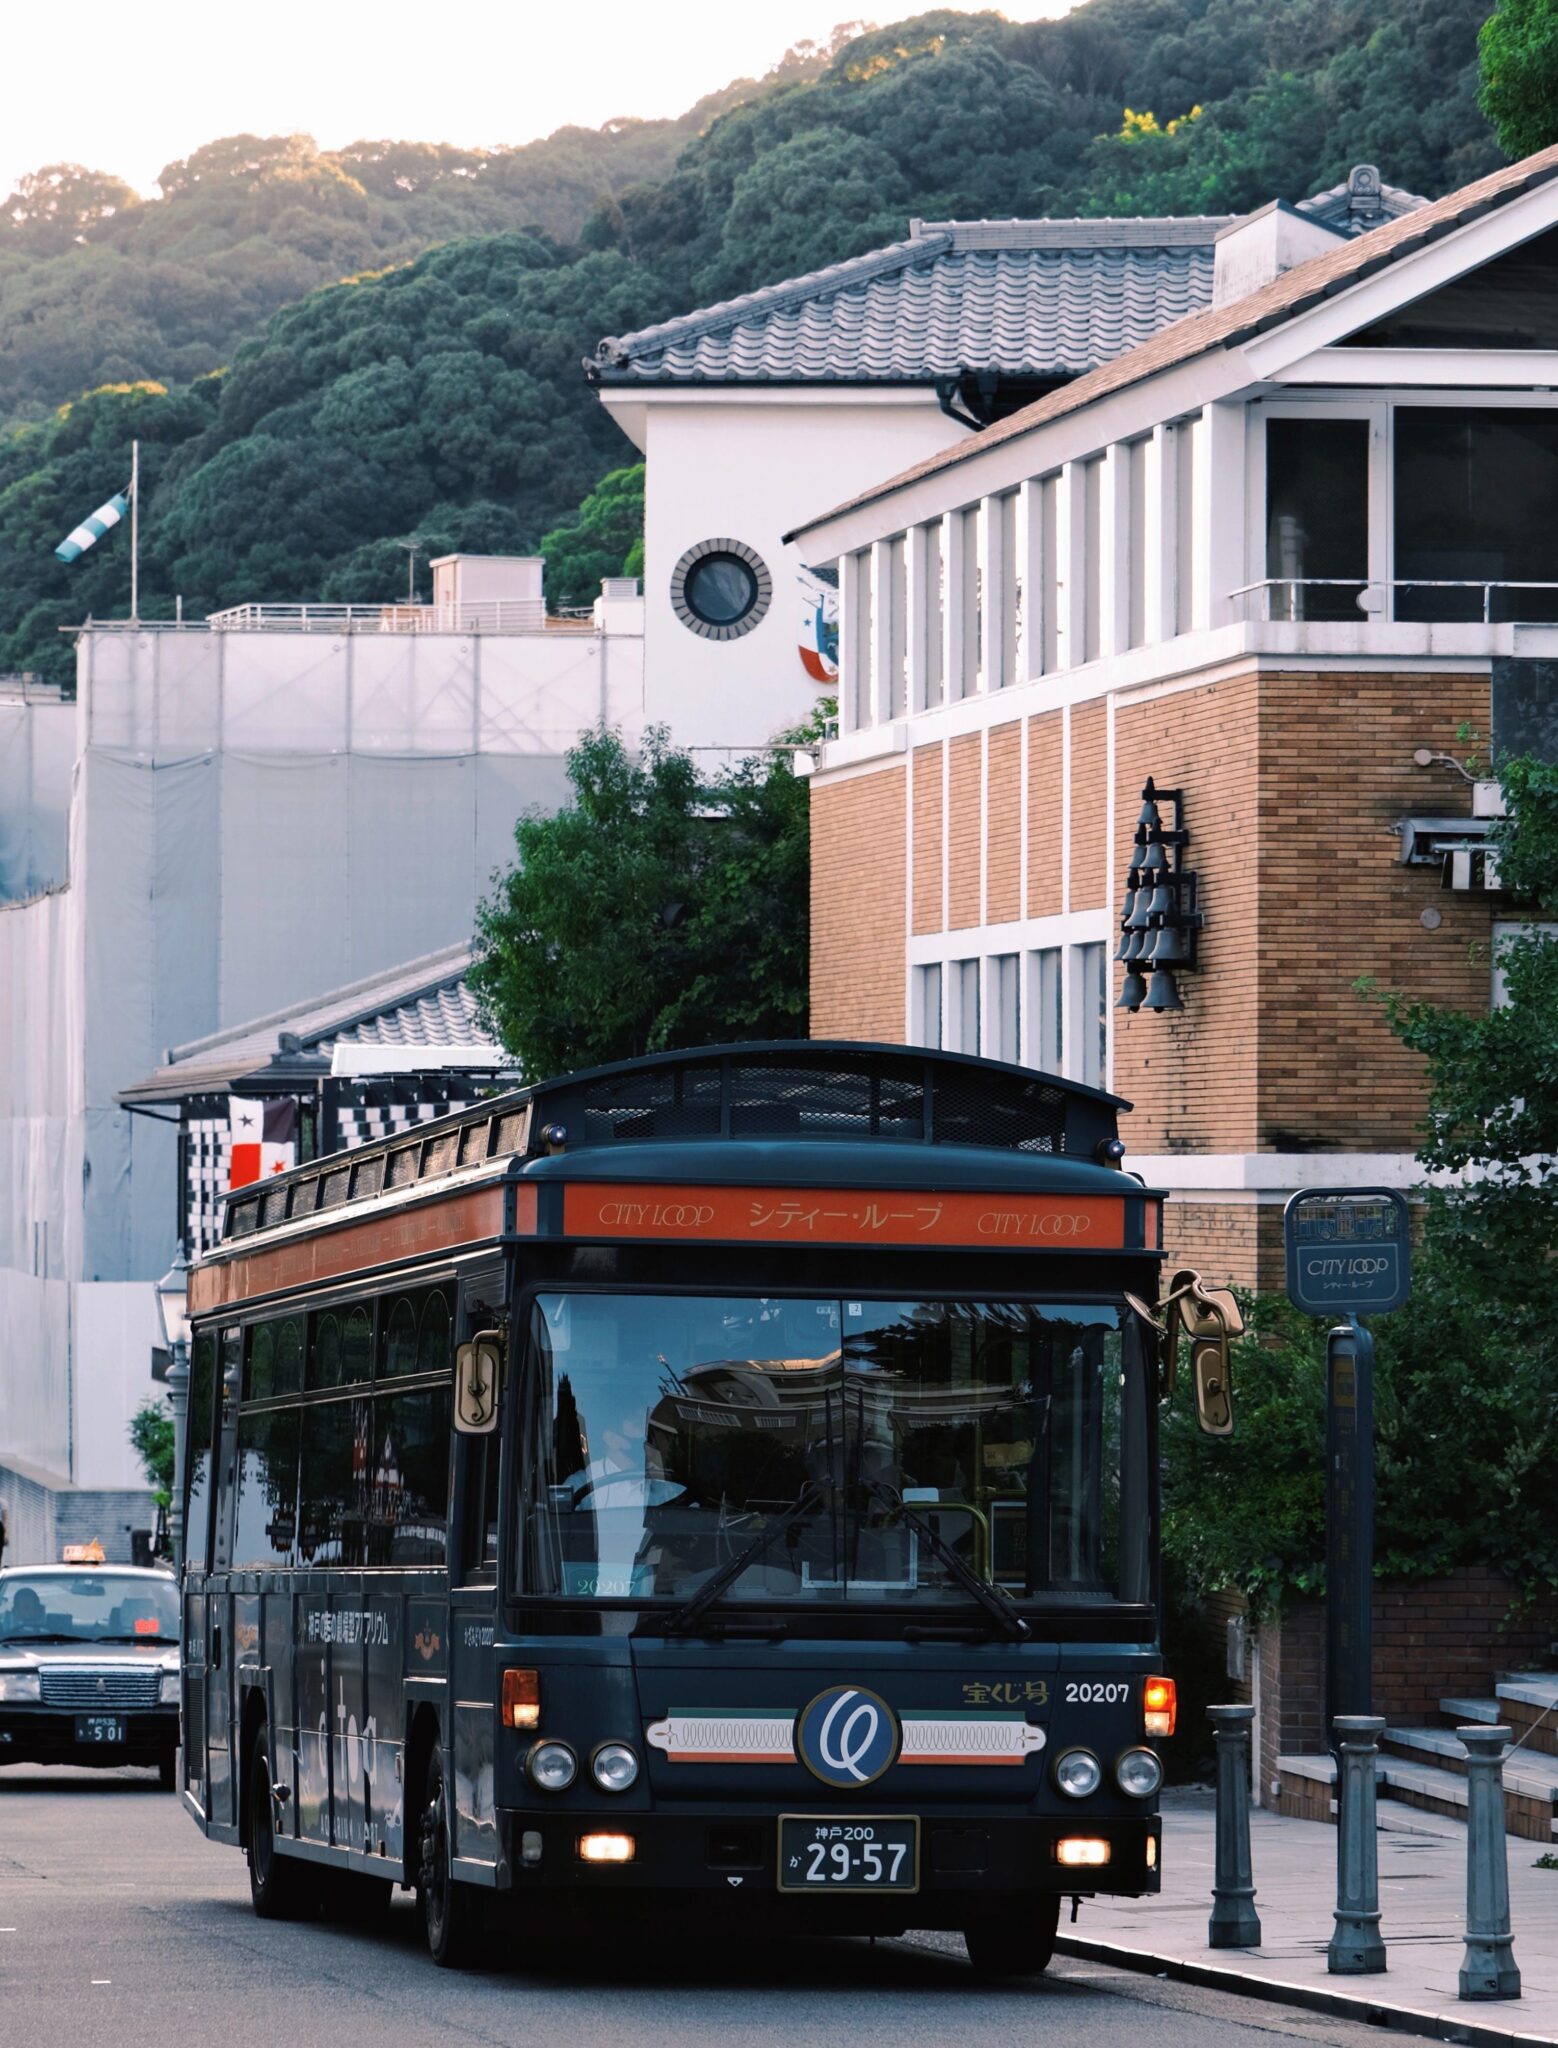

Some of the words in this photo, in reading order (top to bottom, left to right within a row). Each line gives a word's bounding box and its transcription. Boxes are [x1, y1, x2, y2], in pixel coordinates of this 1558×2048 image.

[599, 1203, 650, 1225] CITY
[652, 1203, 714, 1227] LOOP
[750, 1201, 943, 1231] シティー・ループ
[977, 1212, 1029, 1234] CITY
[1029, 1213, 1090, 1236] LOOP
[1307, 1258, 1346, 1276] CITY
[1347, 1257, 1389, 1275] LOOP
[577, 1578, 636, 1595] 20207
[962, 1681, 1051, 1706] 宝くじ号
[1065, 1683, 1130, 1703] 20207
[789, 1855, 802, 1868] か
[806, 1843, 907, 1881] 29-57
